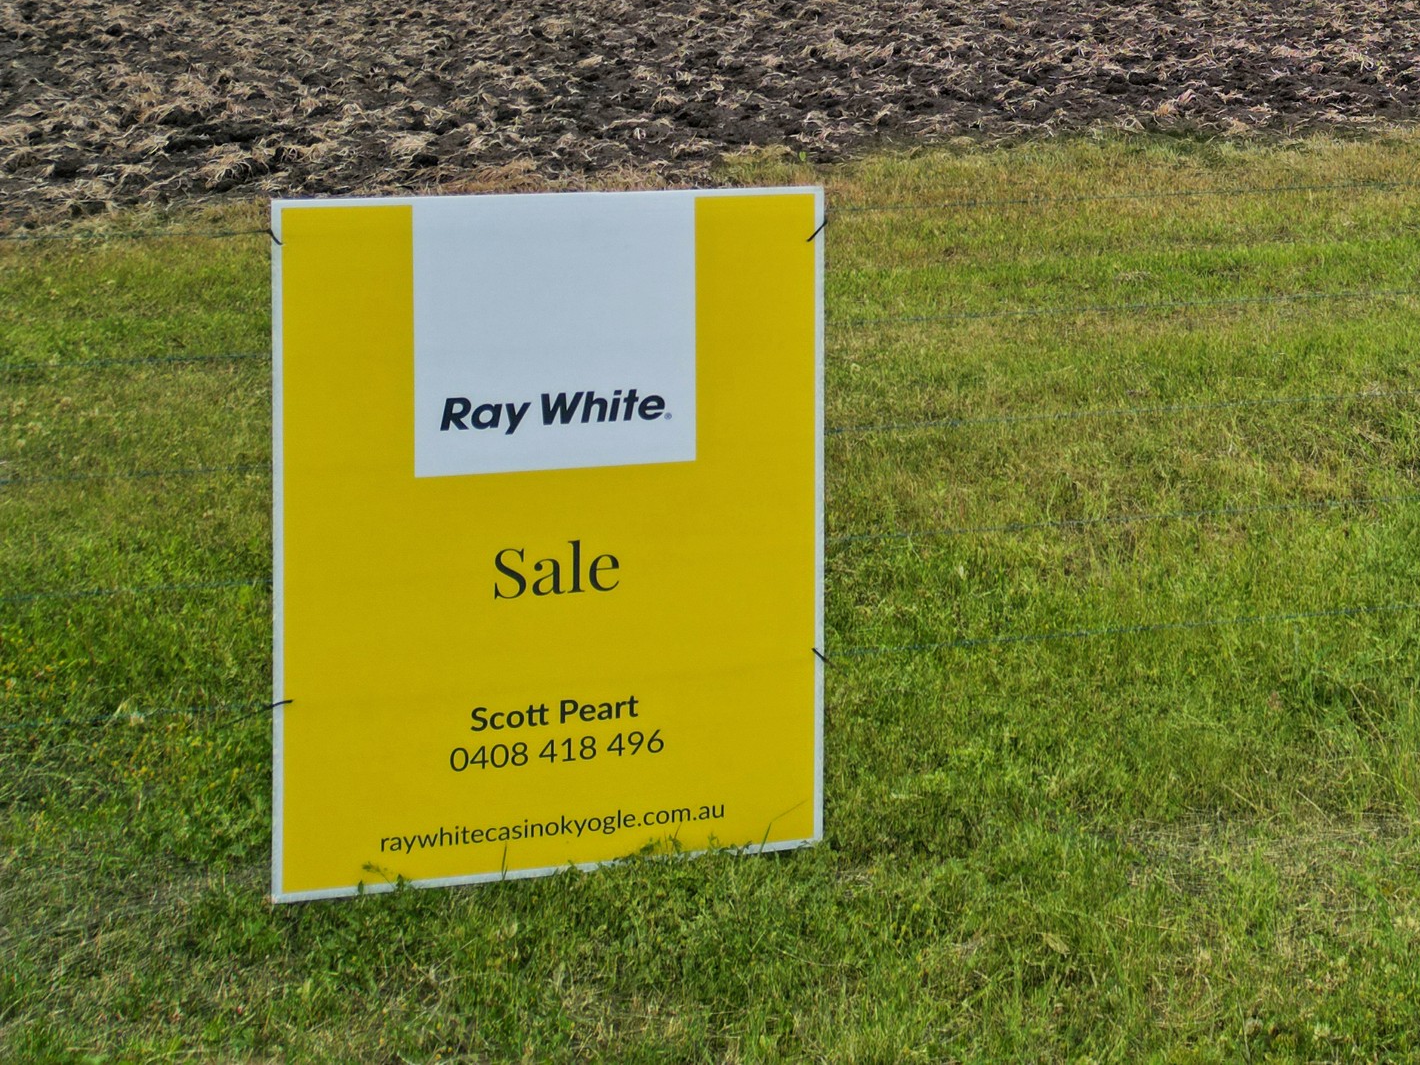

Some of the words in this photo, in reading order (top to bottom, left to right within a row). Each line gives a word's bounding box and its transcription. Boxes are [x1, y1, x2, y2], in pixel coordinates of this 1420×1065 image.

[440, 397, 532, 436] Ray
[541, 388, 666, 426] White
[493, 540, 621, 601] Sale
[470, 703, 550, 733] Scott
[559, 695, 639, 724] Peart
[449, 741, 529, 772] 0408
[538, 735, 597, 764] 418
[606, 729, 665, 757] 496
[380, 803, 726, 854] raywhitecasinokyogle.com.au
